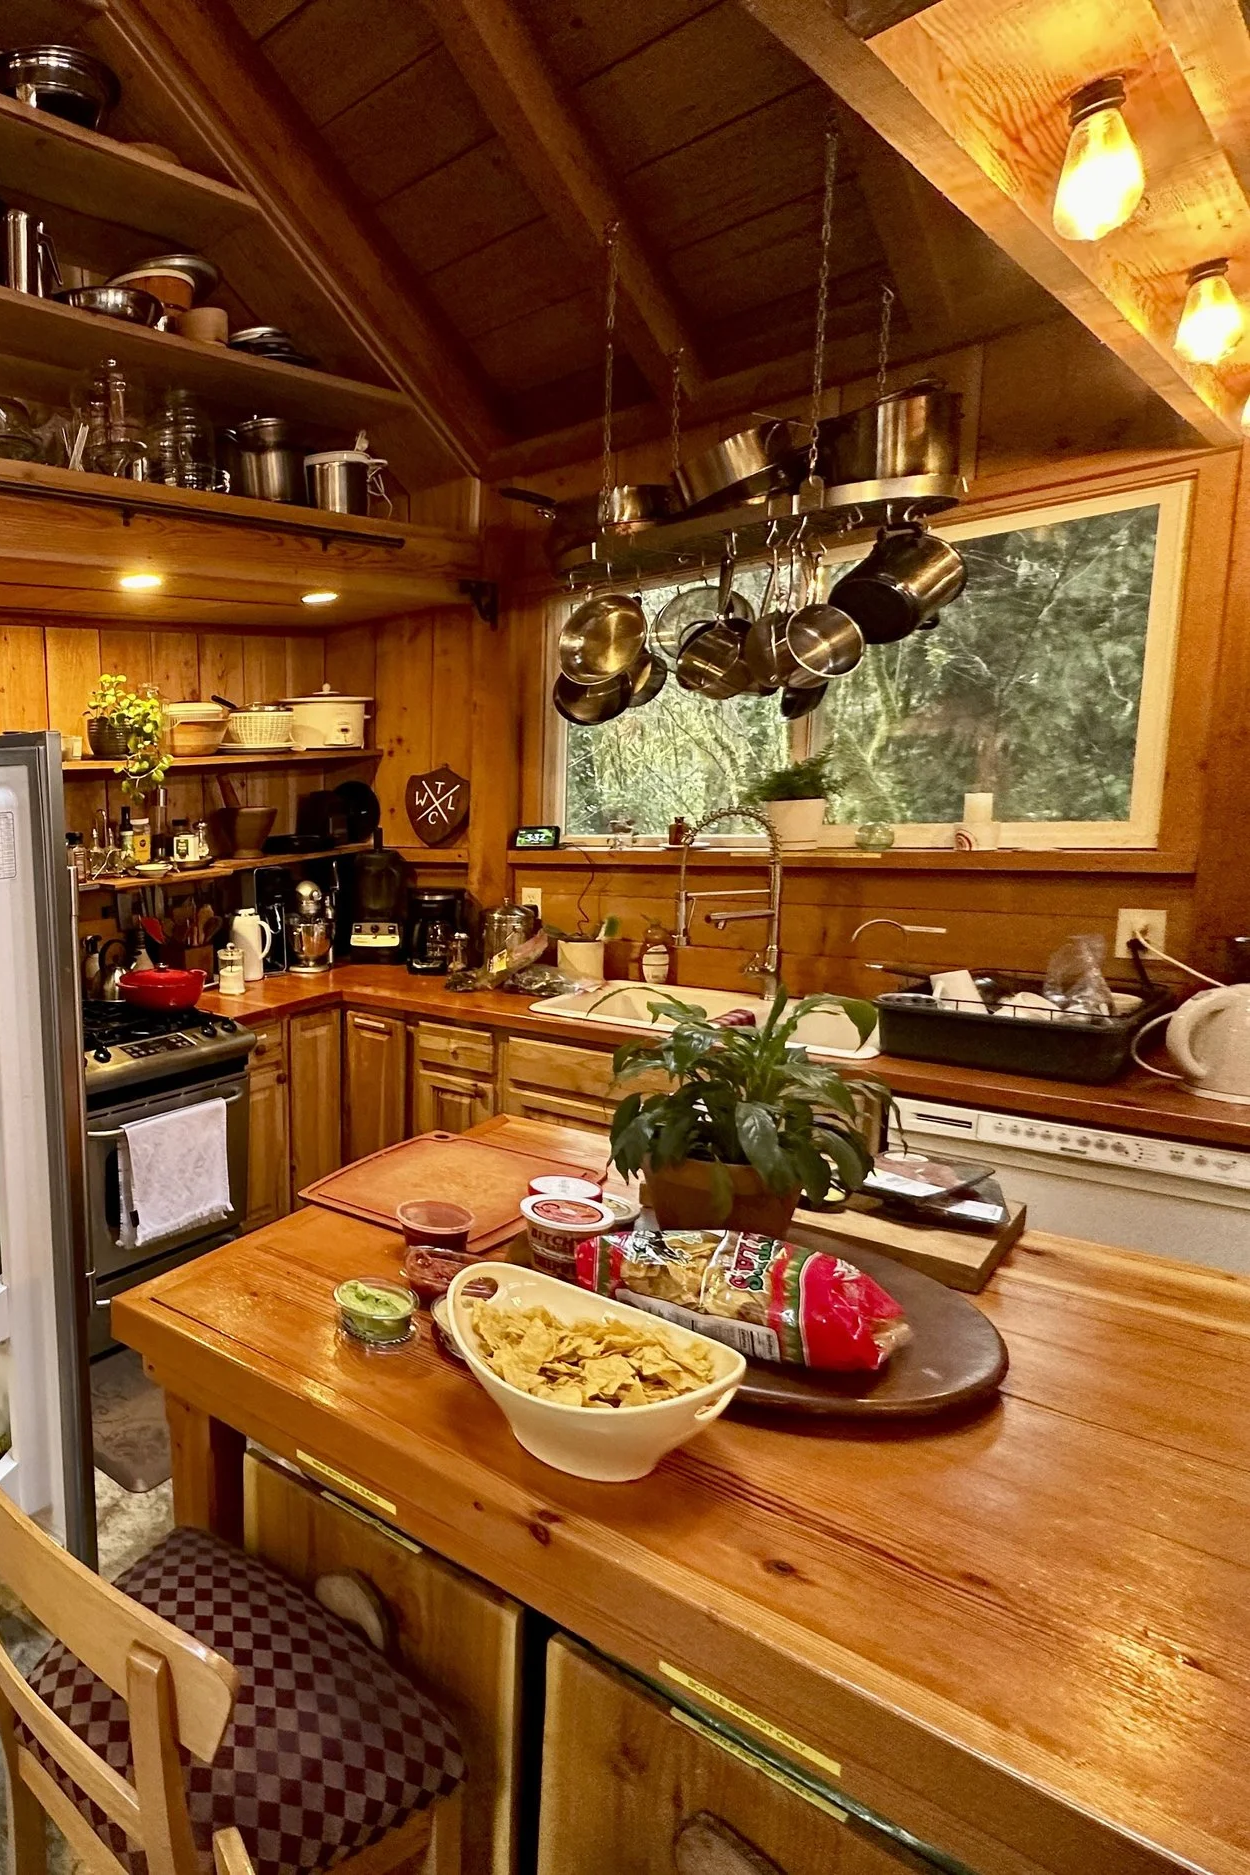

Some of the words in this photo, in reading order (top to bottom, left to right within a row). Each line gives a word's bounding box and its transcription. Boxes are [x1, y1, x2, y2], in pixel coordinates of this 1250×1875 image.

[435, 781, 446, 794] T
[415, 791, 429, 807] W
[447, 795, 455, 810] L
[428, 811, 439, 825] C
[687, 1678, 727, 1706] BOTTLE
[727, 1703, 773, 1734] DEPOSIT
[775, 1729, 806, 1753] ONLY
